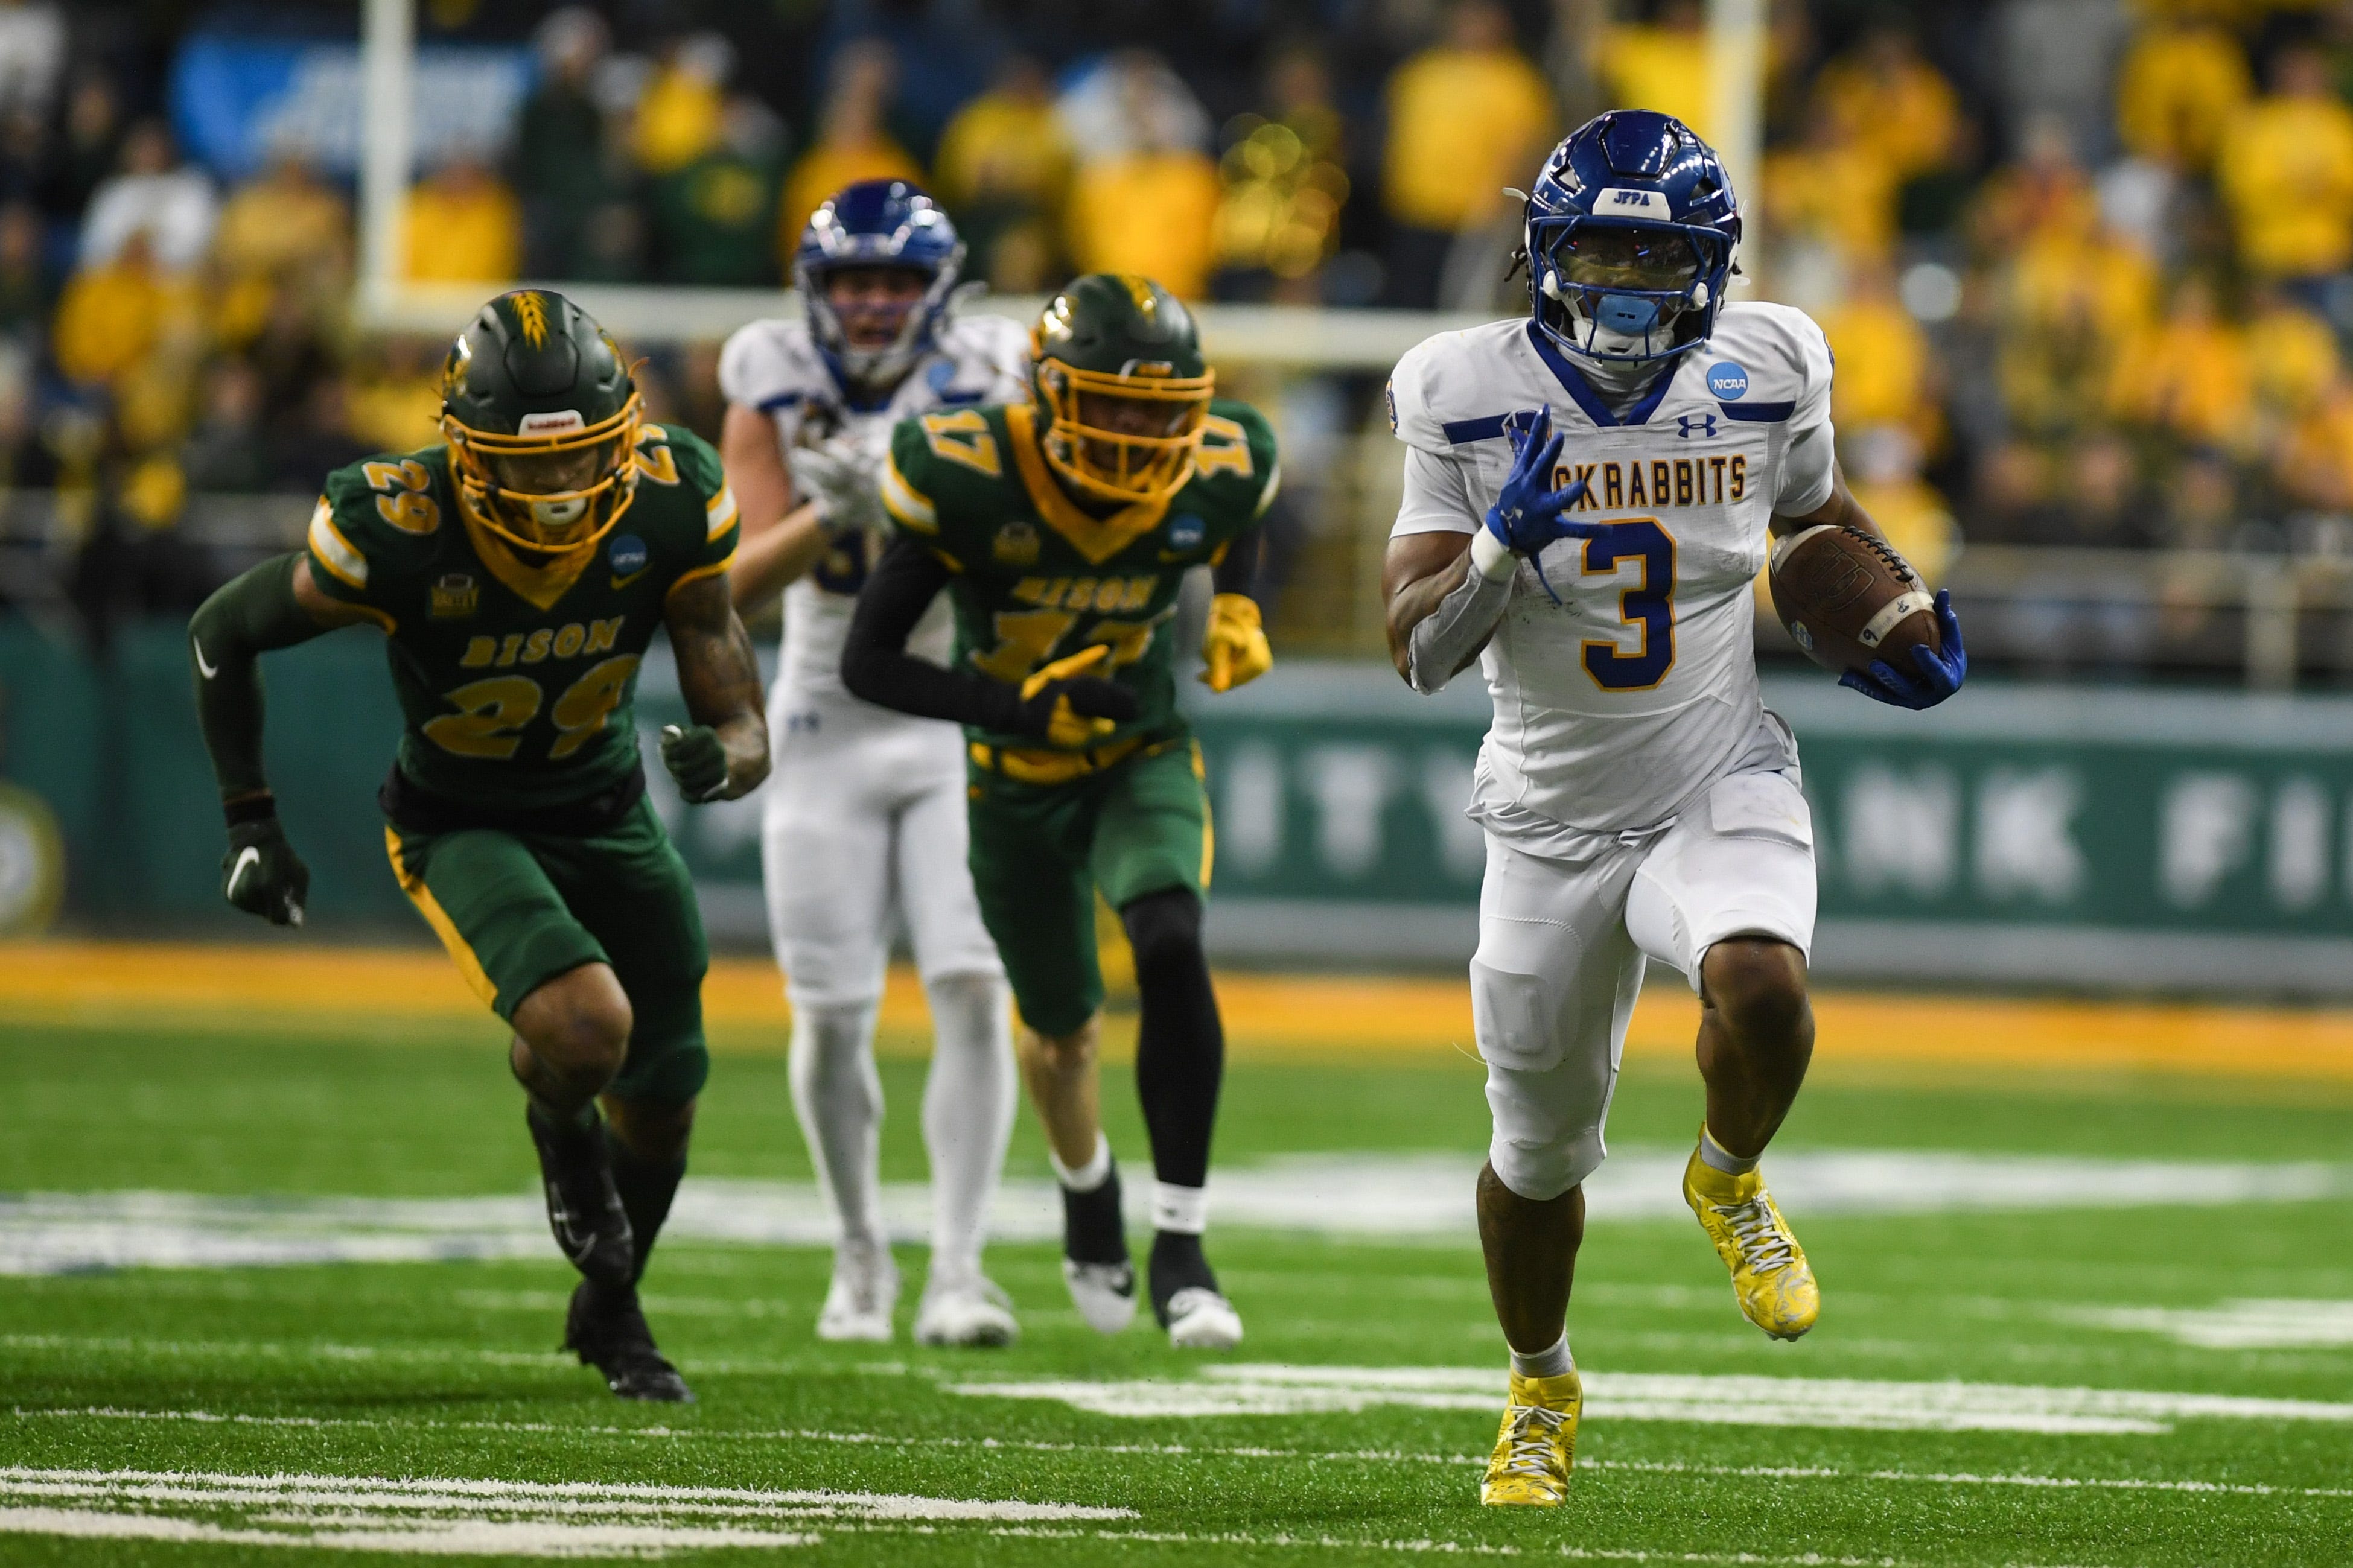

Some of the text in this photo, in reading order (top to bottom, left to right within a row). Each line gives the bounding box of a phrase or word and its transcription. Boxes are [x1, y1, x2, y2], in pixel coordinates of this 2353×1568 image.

[1713, 378, 1746, 390] NCAA
[919, 410, 1002, 477] 17
[361, 459, 441, 536] 29
[1552, 454, 1747, 513] CKRABBITS
[1581, 516, 1676, 693] 3
[459, 615, 626, 668] BISON
[421, 653, 642, 760] 29
[2159, 766, 2353, 912] FI
